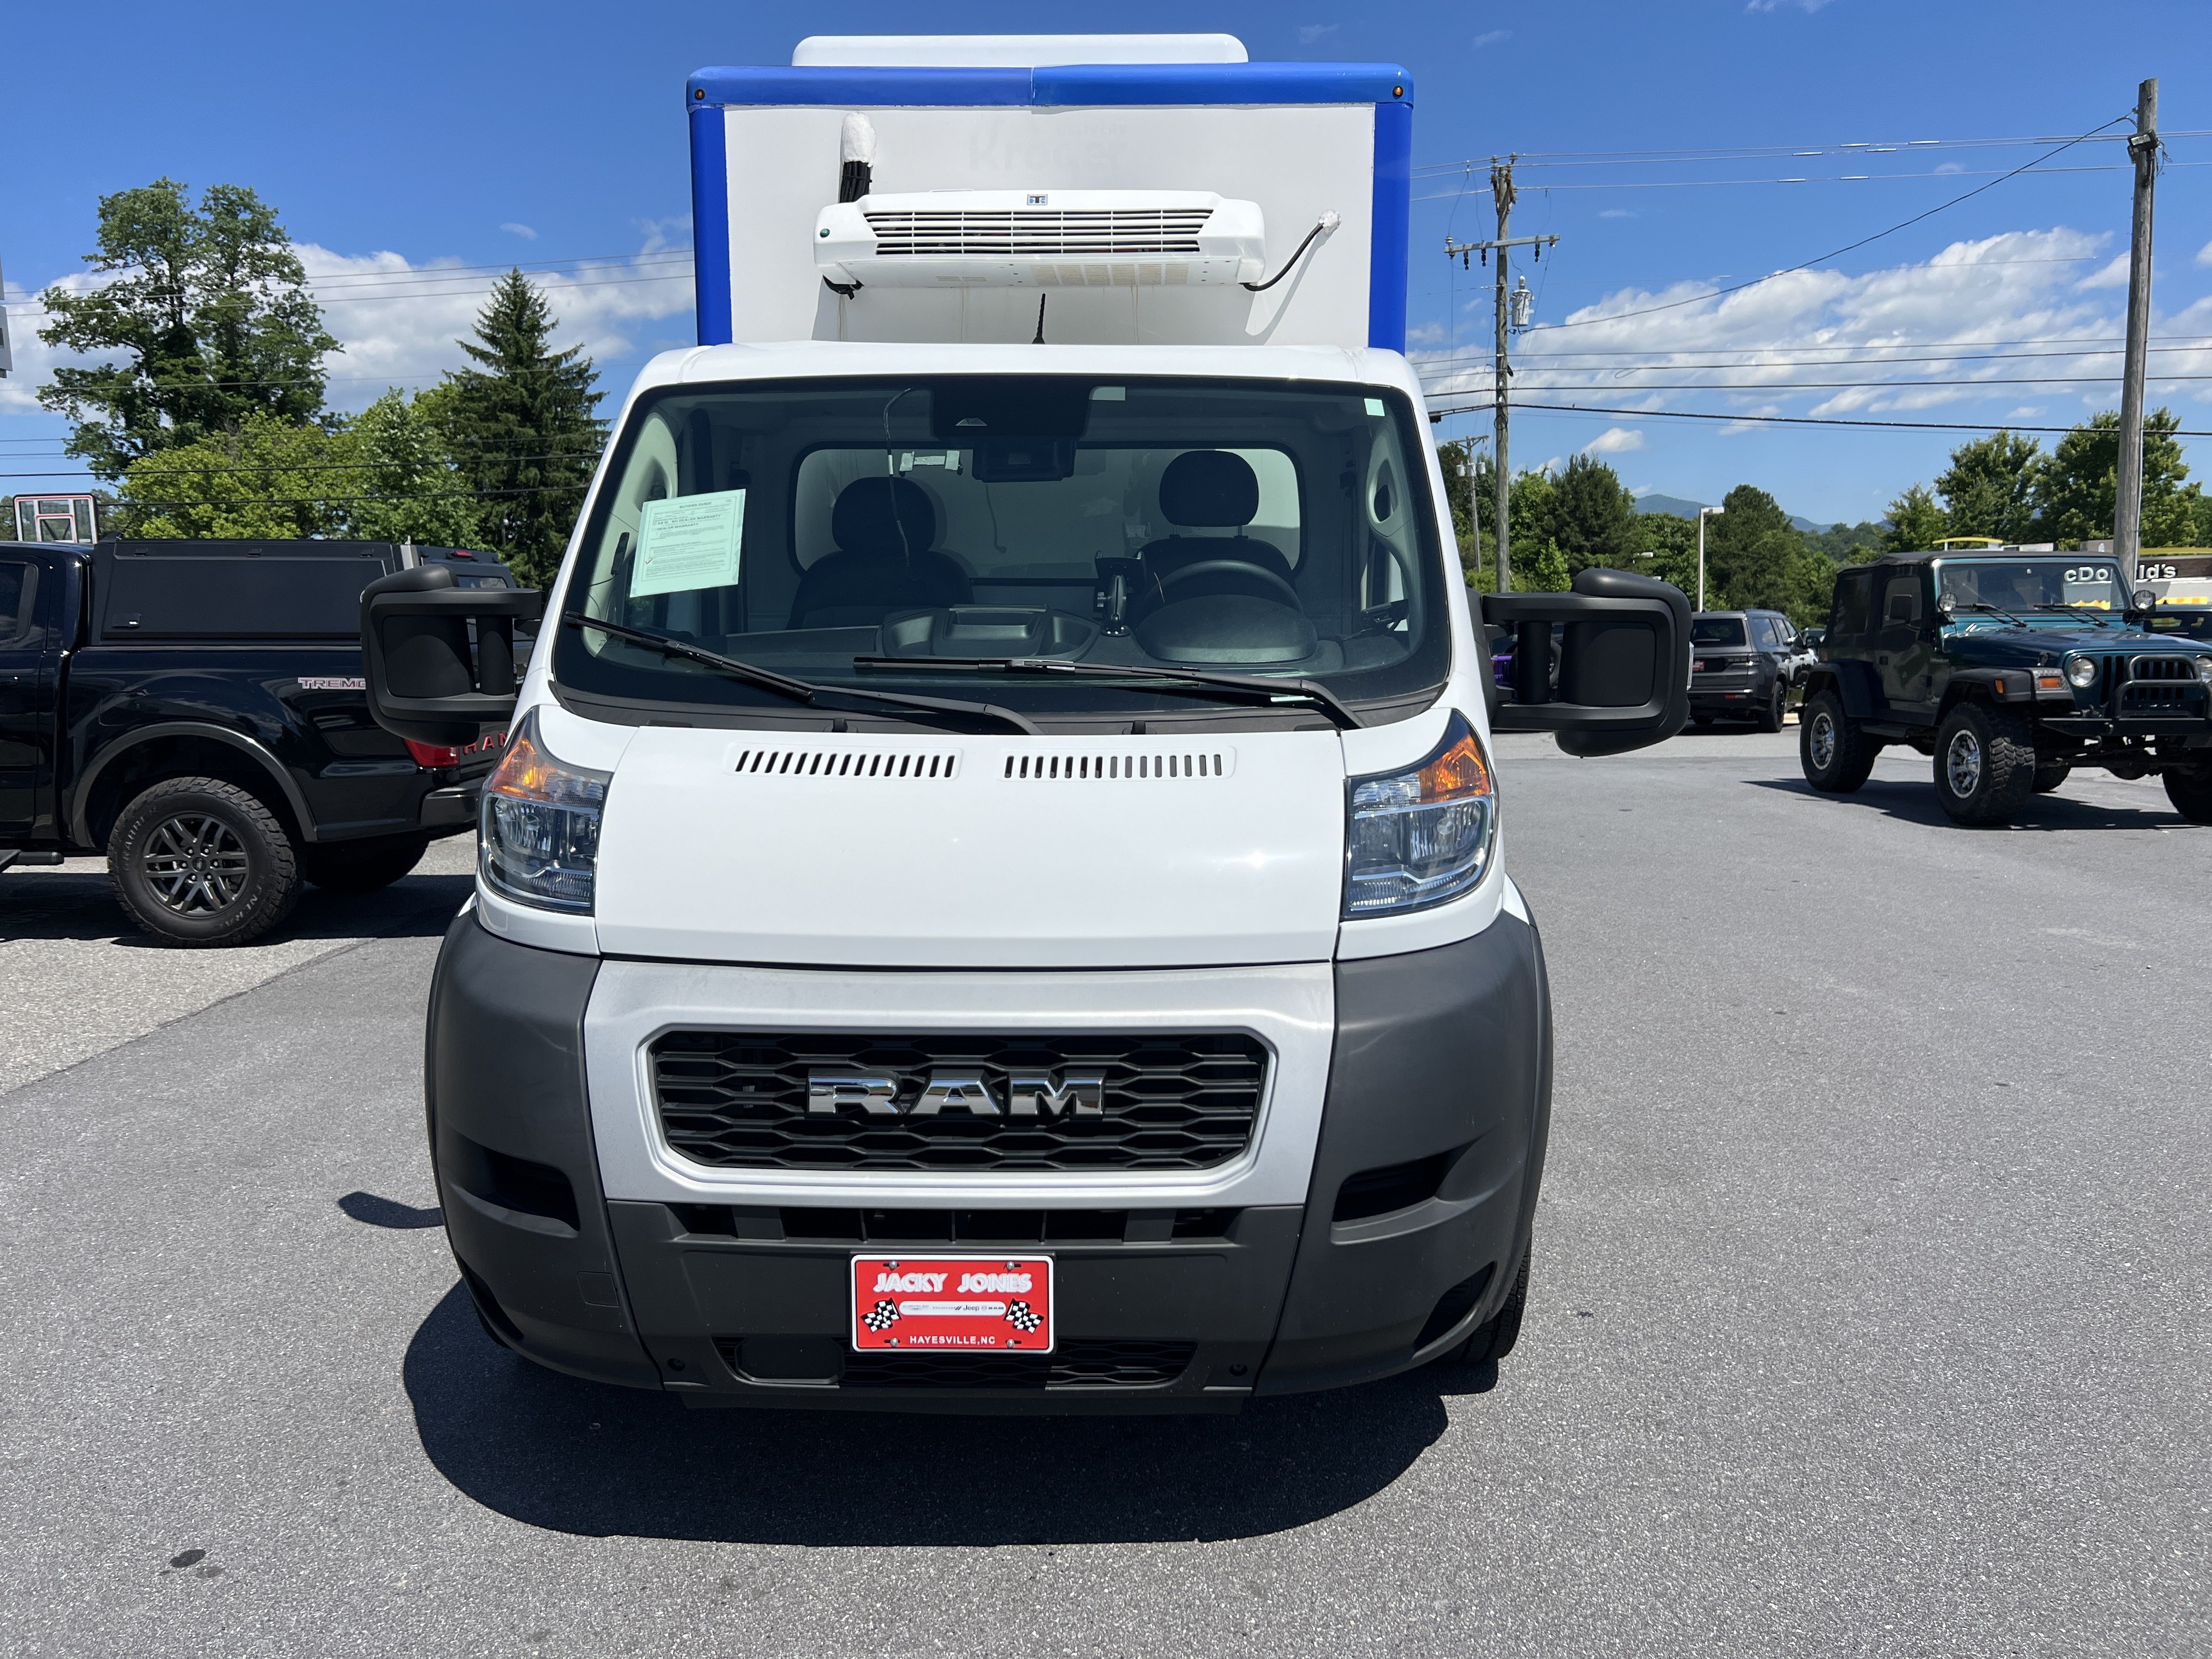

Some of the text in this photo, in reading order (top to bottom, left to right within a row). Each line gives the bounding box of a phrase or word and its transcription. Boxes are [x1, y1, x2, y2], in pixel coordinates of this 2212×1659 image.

[808, 1071, 1107, 1115] RAM
[873, 1272, 1033, 1293] JACKY JONES
[910, 1335, 996, 1345] HAYESVILLE,NC
